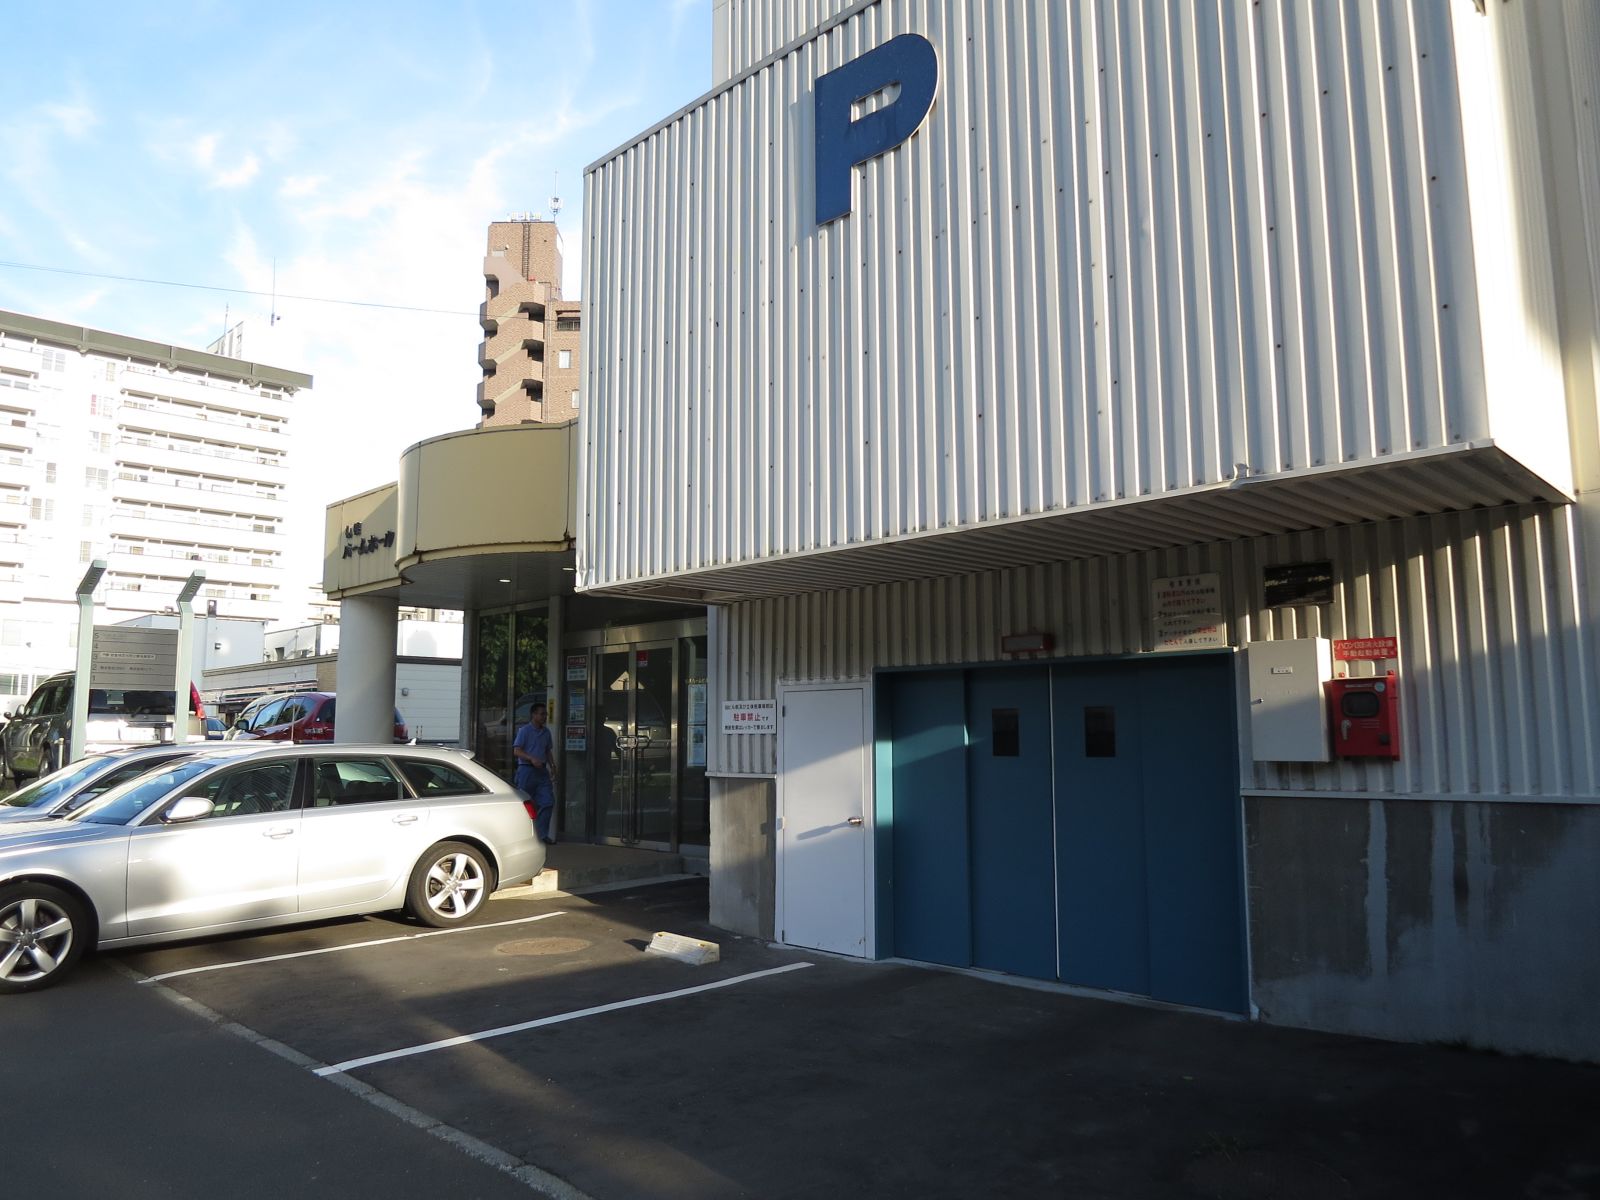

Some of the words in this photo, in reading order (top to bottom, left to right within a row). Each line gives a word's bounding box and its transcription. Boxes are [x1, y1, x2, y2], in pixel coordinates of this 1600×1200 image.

[815, 33, 939, 226] P
[733, 712, 769, 721] 駐車禁止です
